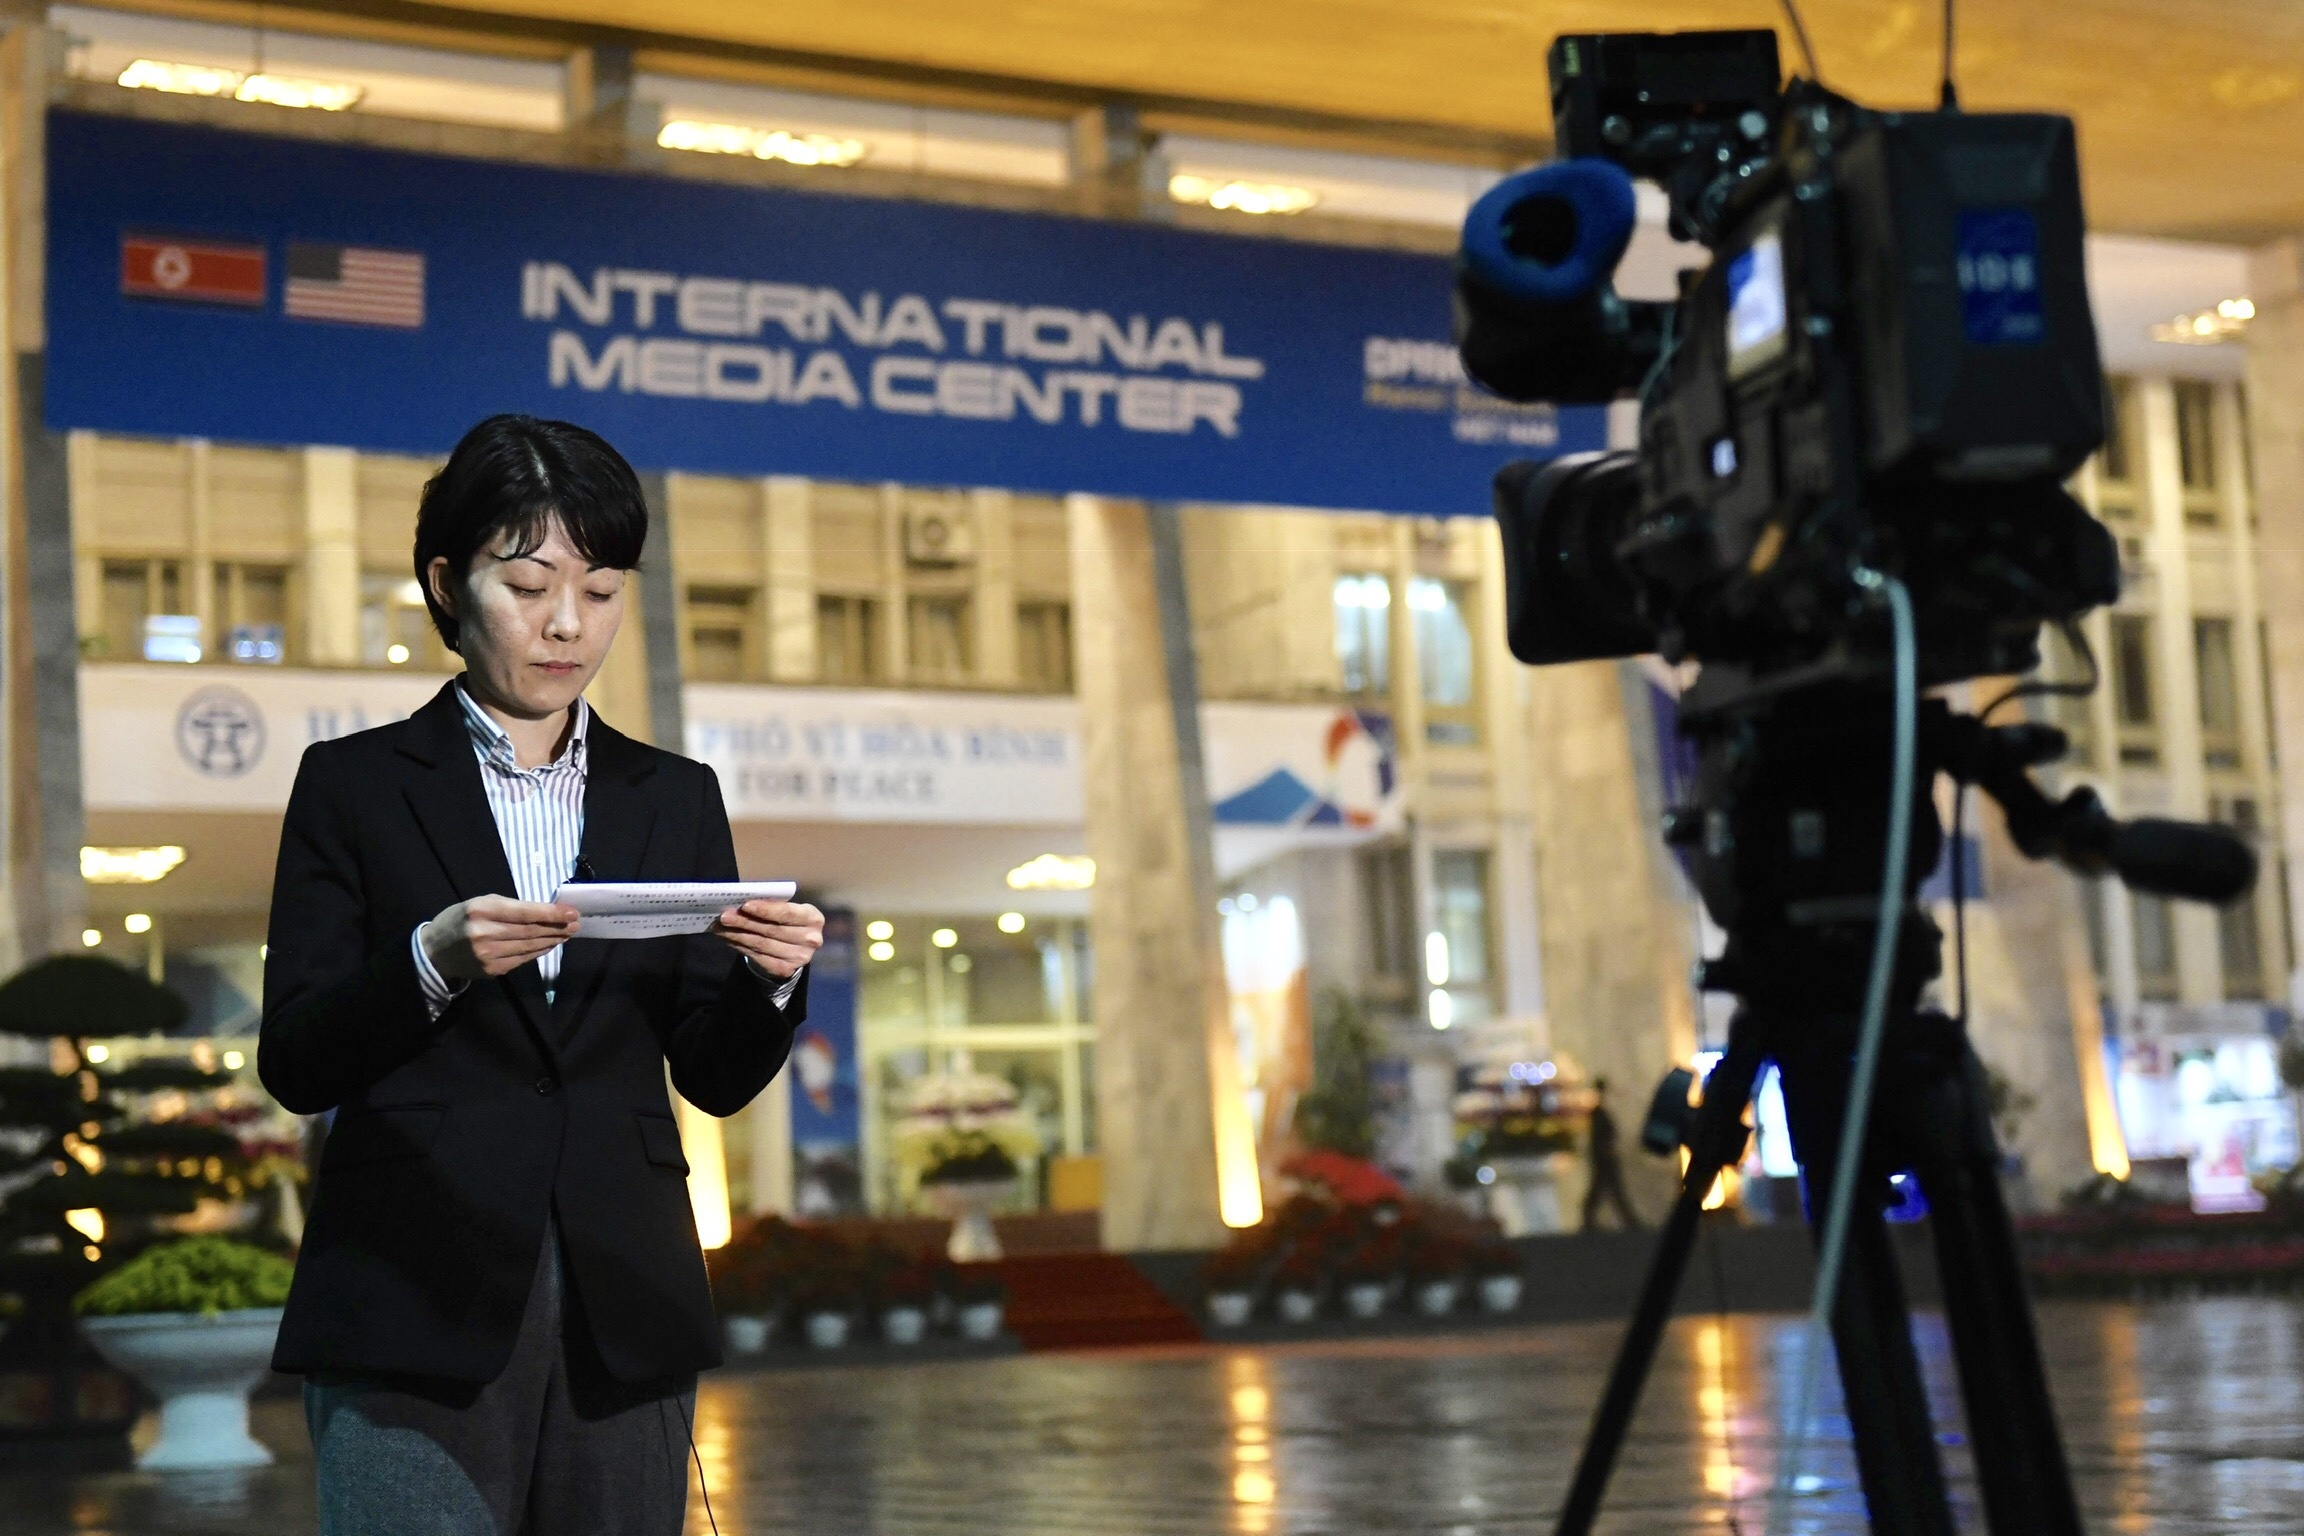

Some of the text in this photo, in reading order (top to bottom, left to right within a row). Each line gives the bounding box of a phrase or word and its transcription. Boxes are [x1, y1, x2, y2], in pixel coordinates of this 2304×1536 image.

[522, 261, 1264, 379] INTERNATIONAL
[549, 330, 1242, 438] MEDIA CENTER
[738, 766, 936, 802] FOR PEACE
